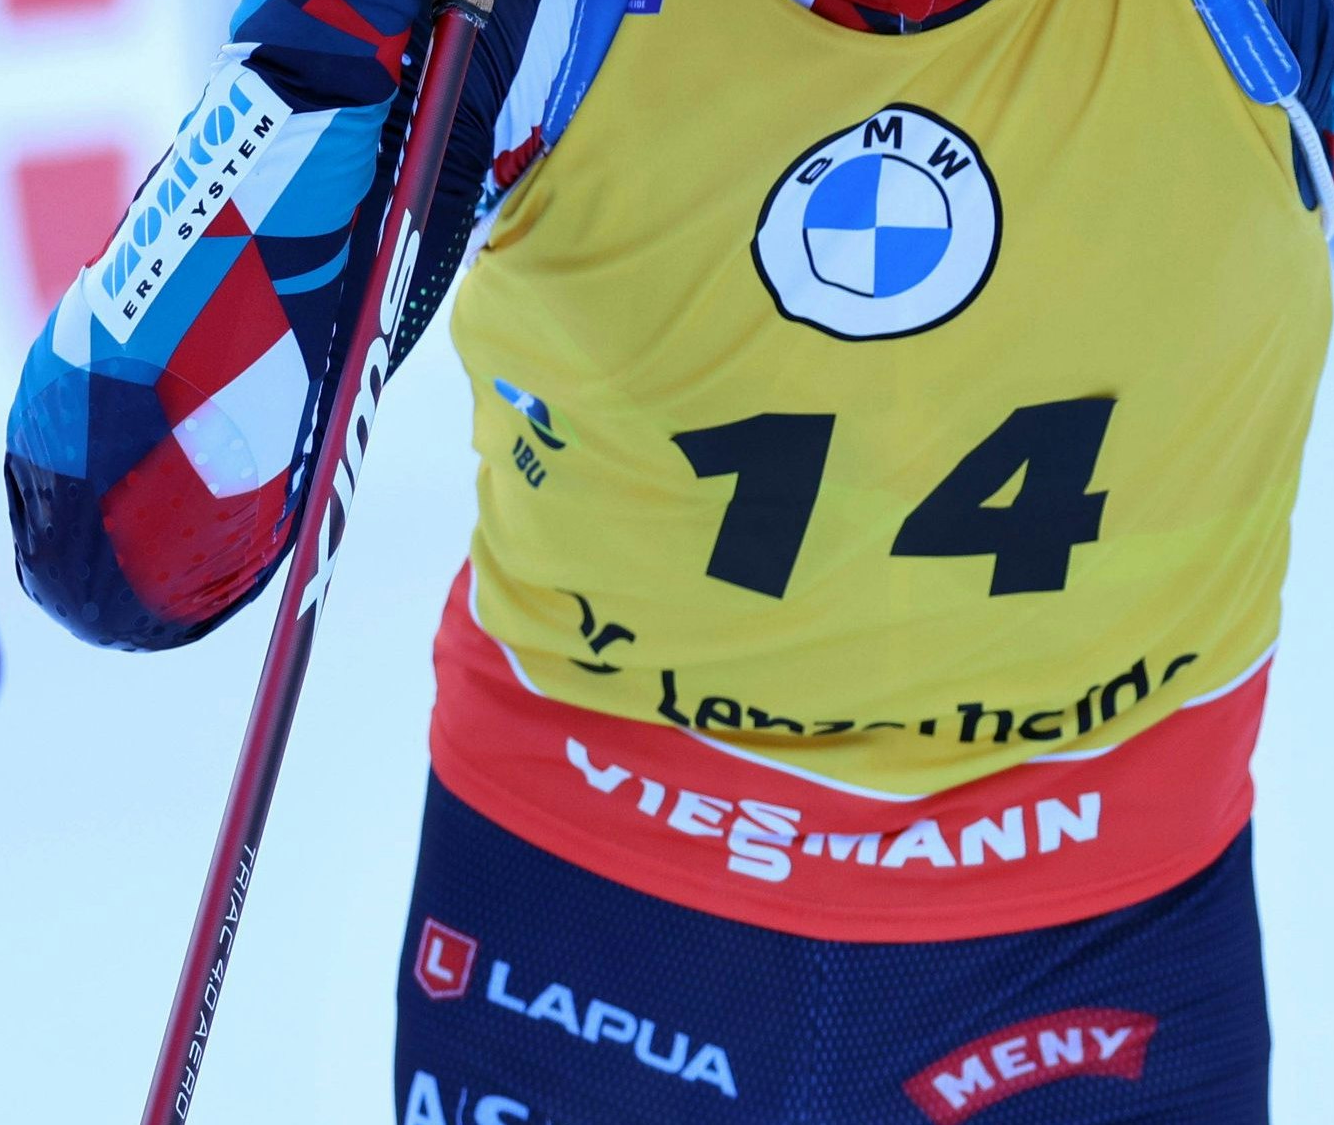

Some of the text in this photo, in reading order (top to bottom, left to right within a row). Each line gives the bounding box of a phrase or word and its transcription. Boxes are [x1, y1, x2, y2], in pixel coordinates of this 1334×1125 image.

[123, 114, 275, 320] ERP SYSTEM
[512, 435, 546, 490] IBU
[670, 396, 1118, 600] 14
[217, 844, 257, 955] TRIAC
[174, 1010, 208, 1121] AERO
[487, 959, 738, 1099] LAPUA
[929, 1024, 1135, 1112] MENY
